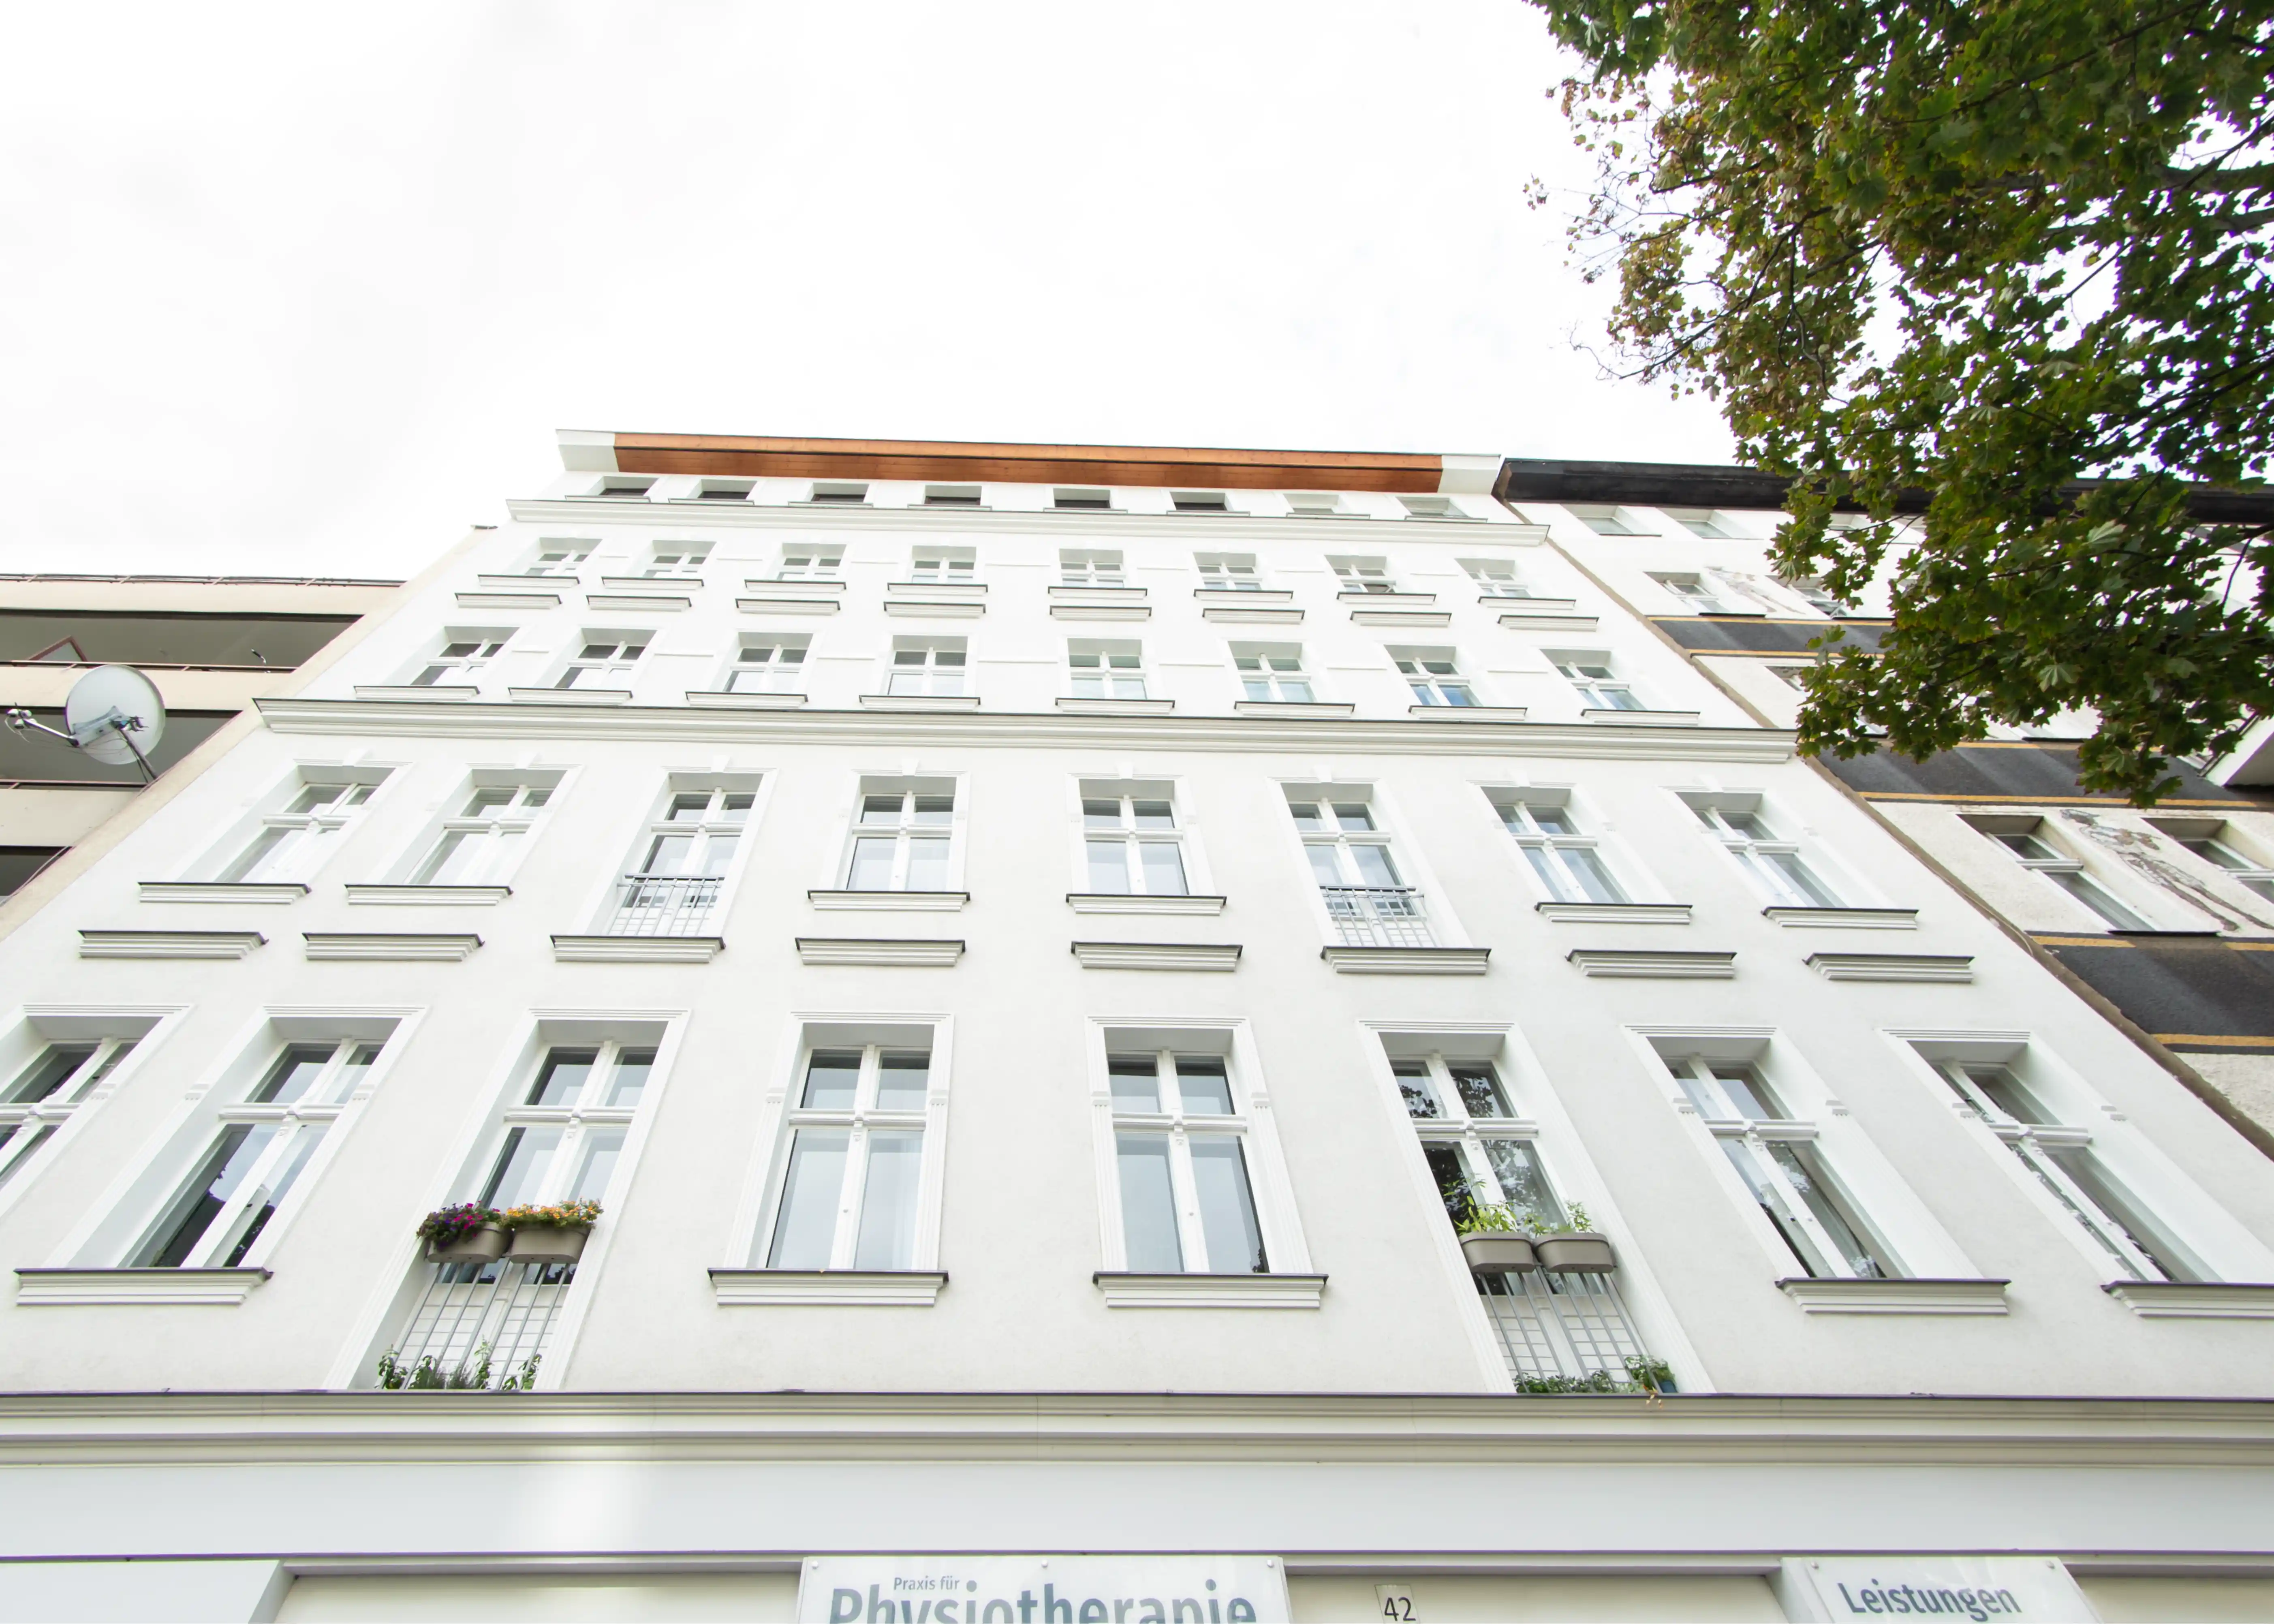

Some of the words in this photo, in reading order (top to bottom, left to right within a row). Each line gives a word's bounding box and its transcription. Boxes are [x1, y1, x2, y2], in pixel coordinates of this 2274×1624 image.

[894, 1575, 935, 1591] Praxis
[940, 1575, 960, 1591] für
[1837, 1578, 2022, 1622] Leistungen
[830, 1579, 1256, 1624] Physiotherapie
[1384, 1596, 1416, 1622] 42
